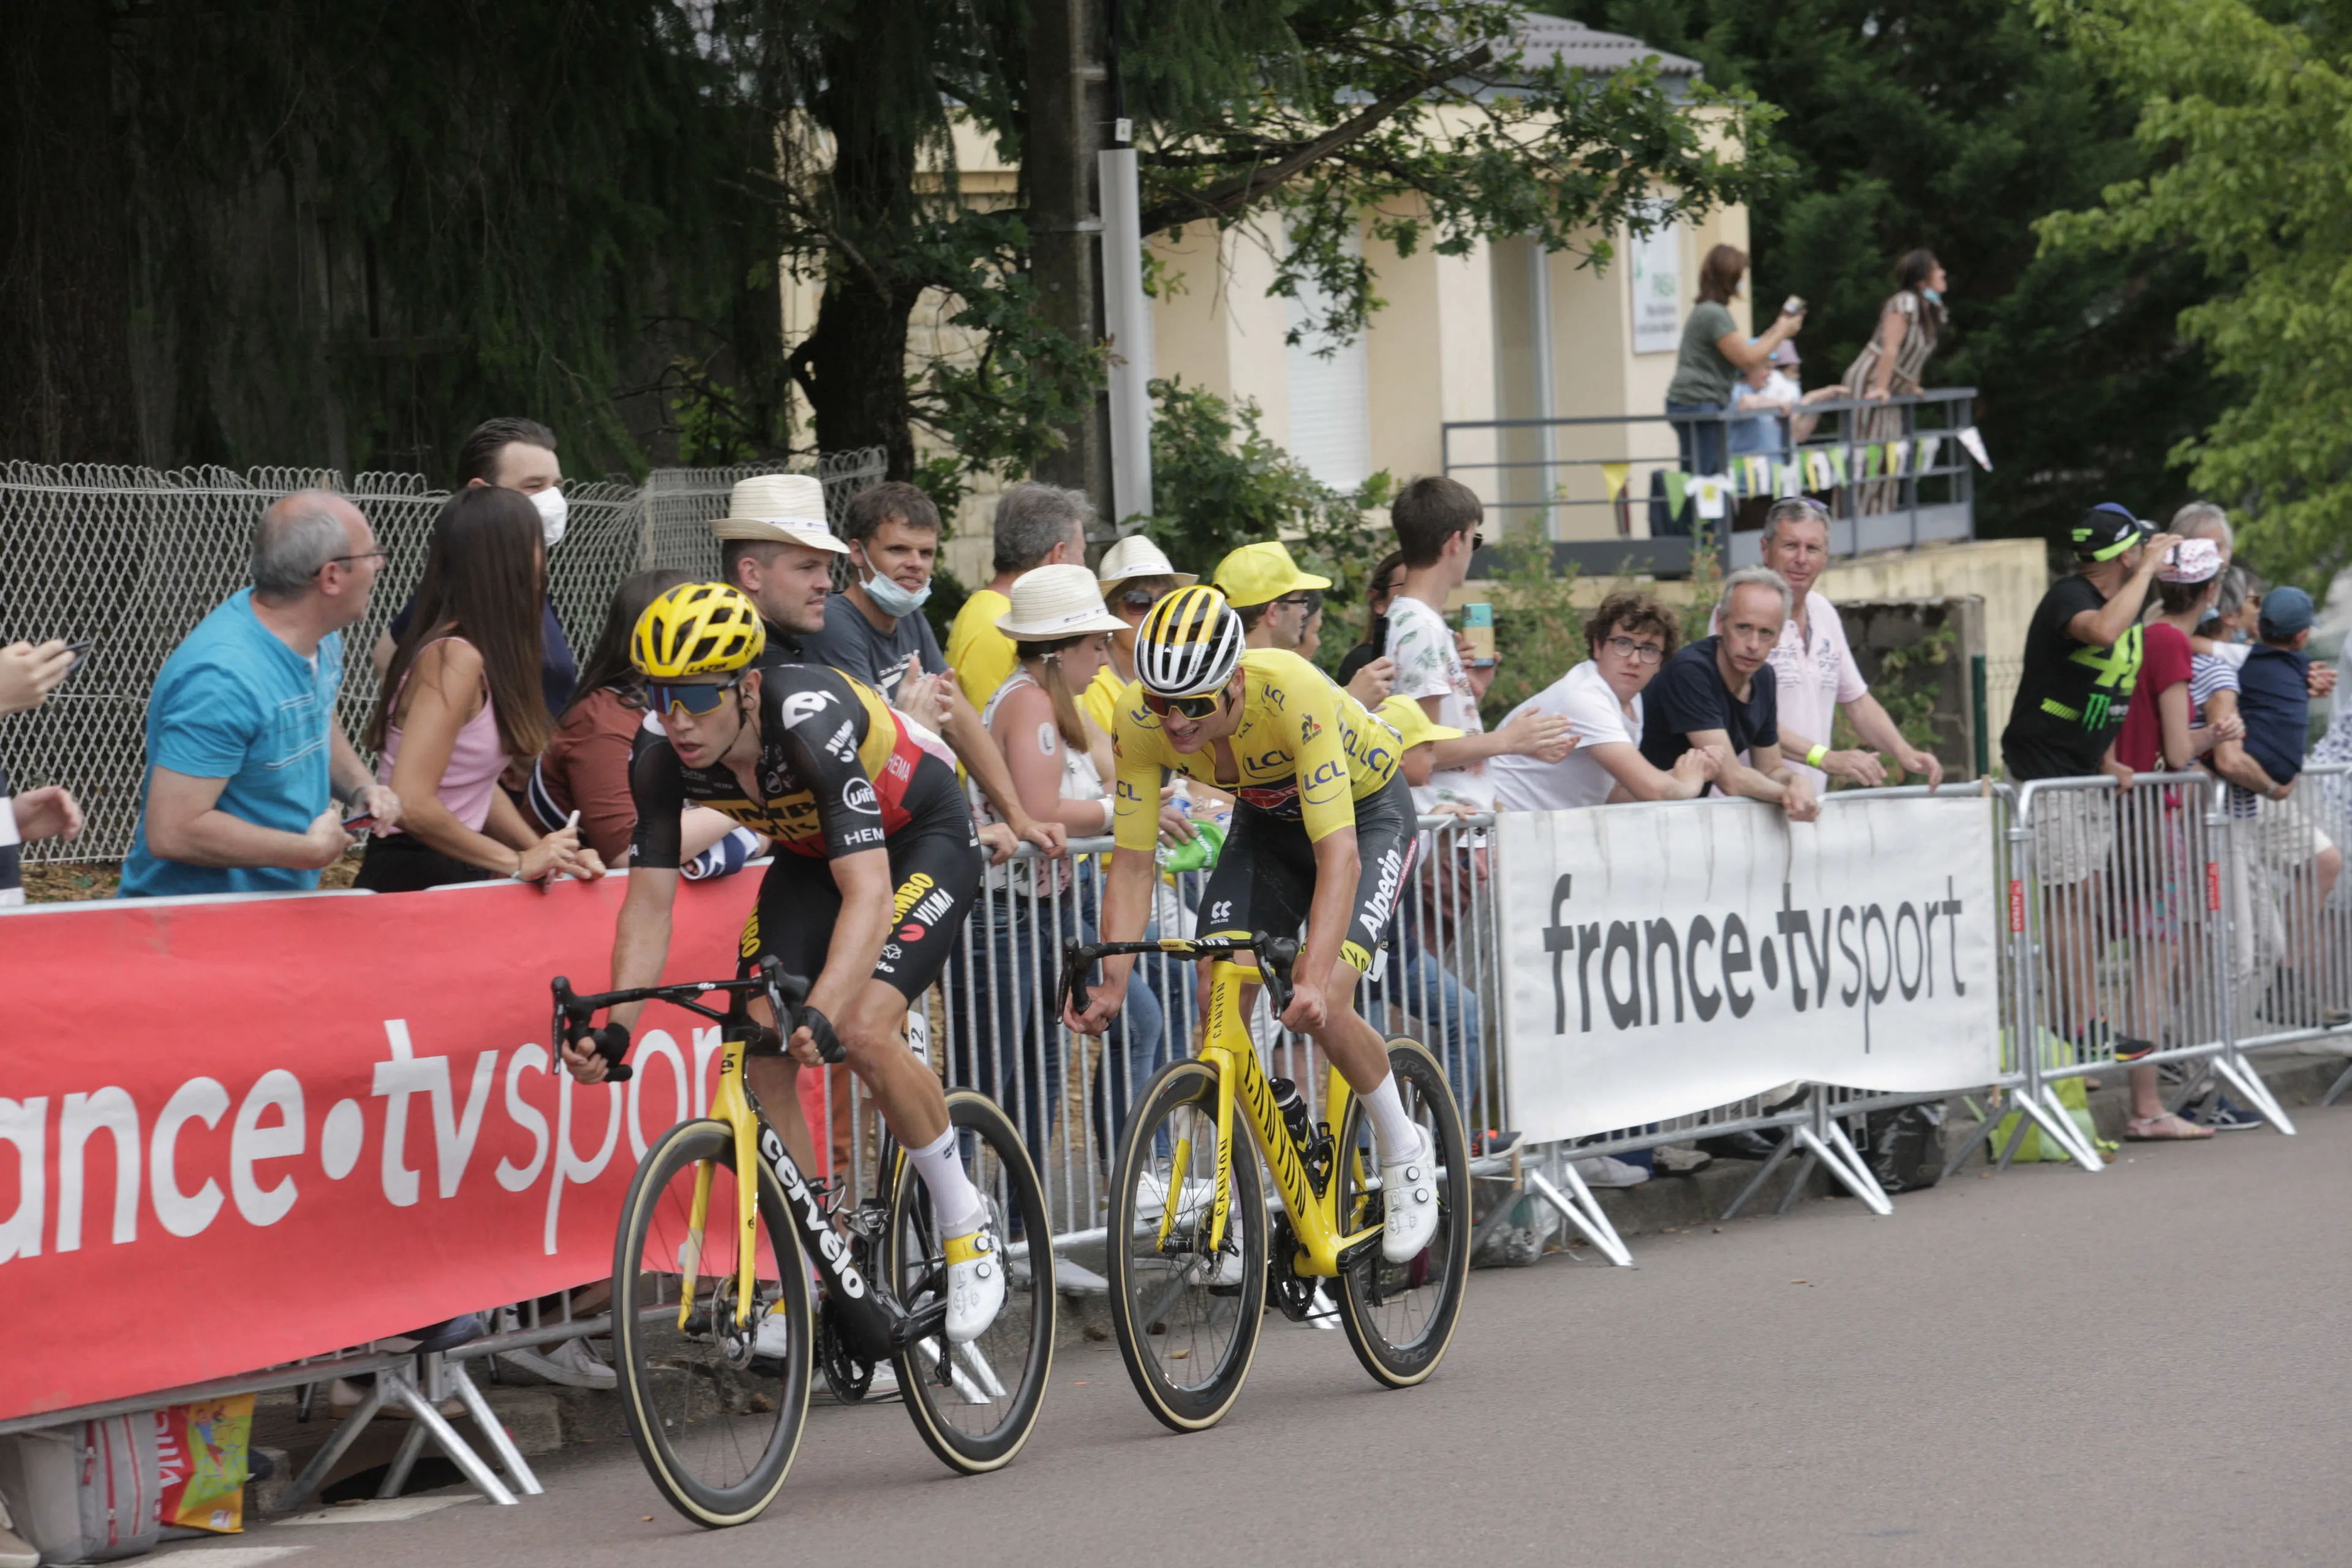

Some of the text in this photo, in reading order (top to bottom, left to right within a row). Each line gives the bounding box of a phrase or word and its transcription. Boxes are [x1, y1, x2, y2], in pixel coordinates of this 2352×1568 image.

[1264, 684, 1286, 712] LCL
[884, 751, 912, 783] HEMA
[1246, 749, 1295, 772] LCL
[1303, 760, 1346, 791] LCL
[1360, 742, 1395, 781] LCL
[1116, 780, 1142, 802] CL
[913, 888, 955, 927] VISMA
[1359, 849, 1401, 943] Alpecin
[1212, 982, 1225, 1039] CANYON
[1244, 1048, 1306, 1219] CANYON
[1215, 1137, 1228, 1217] CANYON
